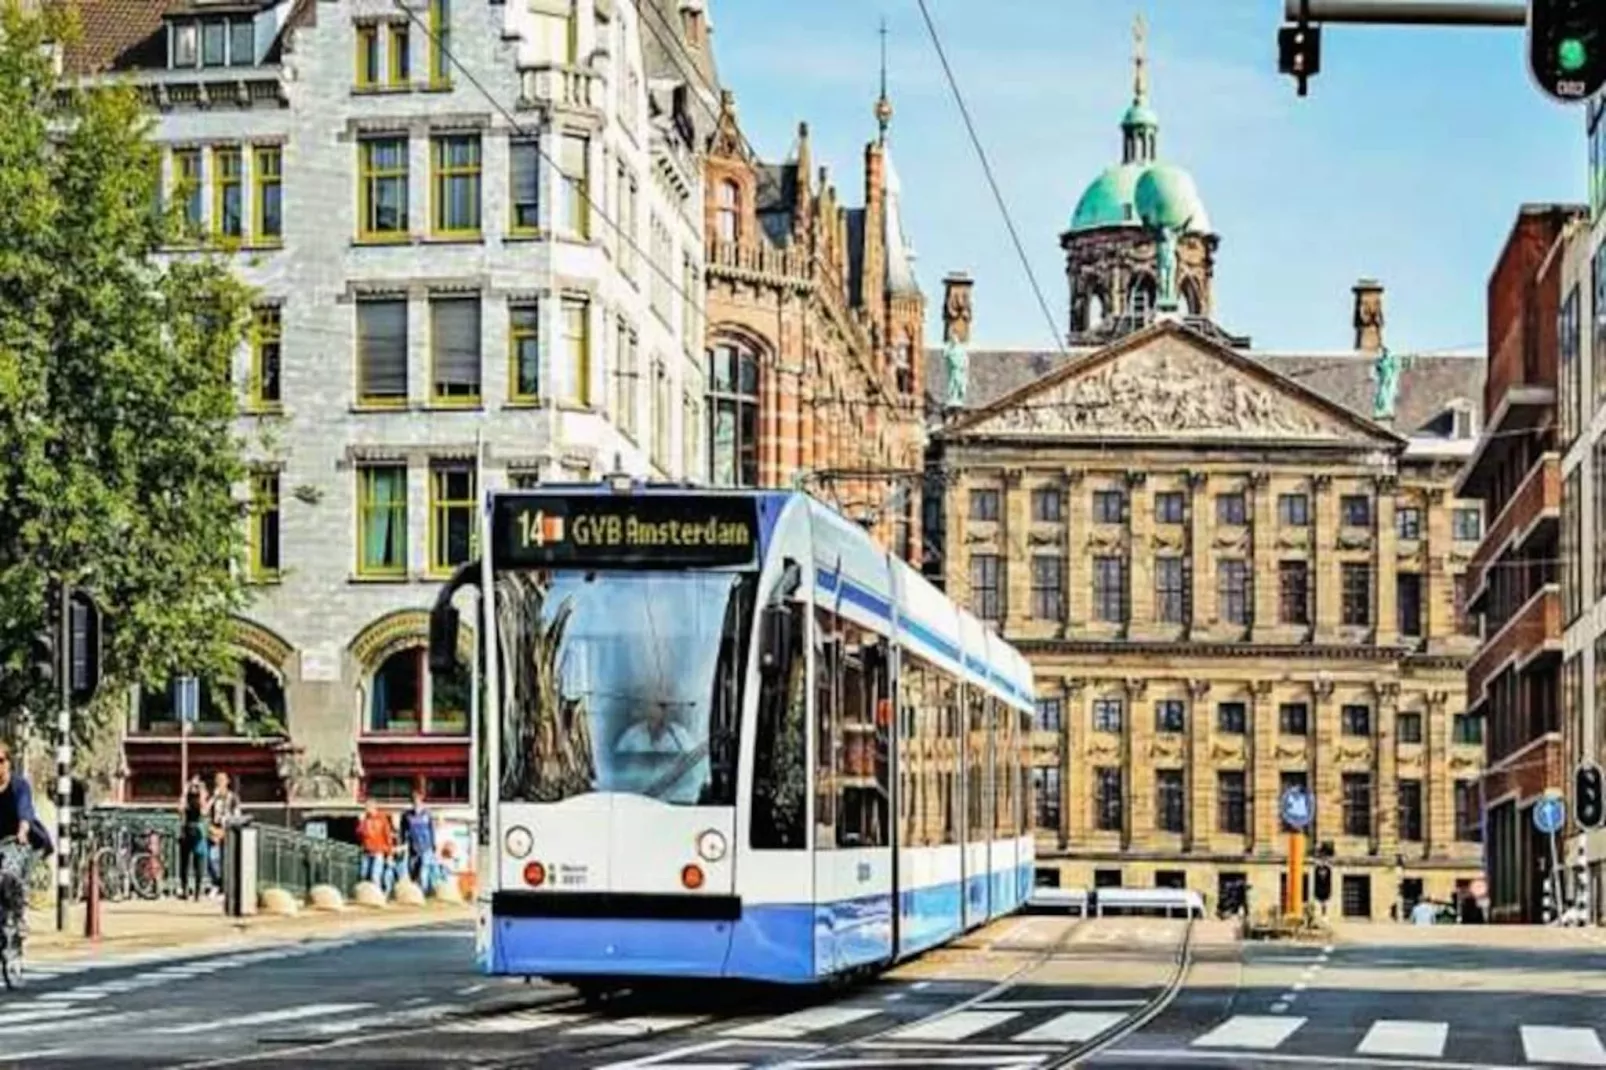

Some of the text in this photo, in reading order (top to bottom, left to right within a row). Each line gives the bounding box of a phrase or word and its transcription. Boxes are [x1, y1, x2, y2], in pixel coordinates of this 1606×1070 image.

[518, 510, 749, 547] 14 GVB Amsterdam
